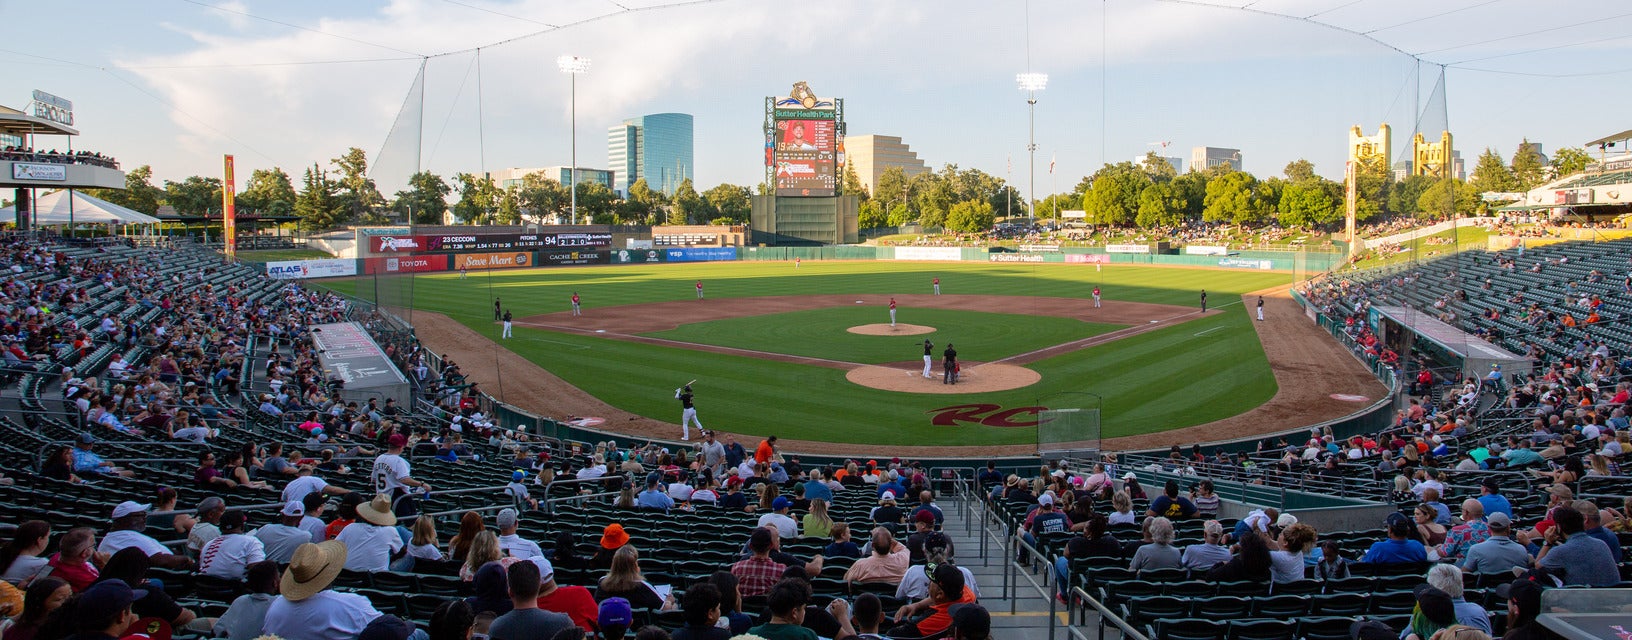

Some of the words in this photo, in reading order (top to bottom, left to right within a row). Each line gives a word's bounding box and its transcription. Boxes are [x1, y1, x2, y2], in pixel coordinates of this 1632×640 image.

[545, 236, 556, 245] 94
[466, 256, 487, 266] Save
[488, 255, 512, 265] Mart
[269, 265, 301, 273] ATLAS
[378, 473, 386, 490] 5
